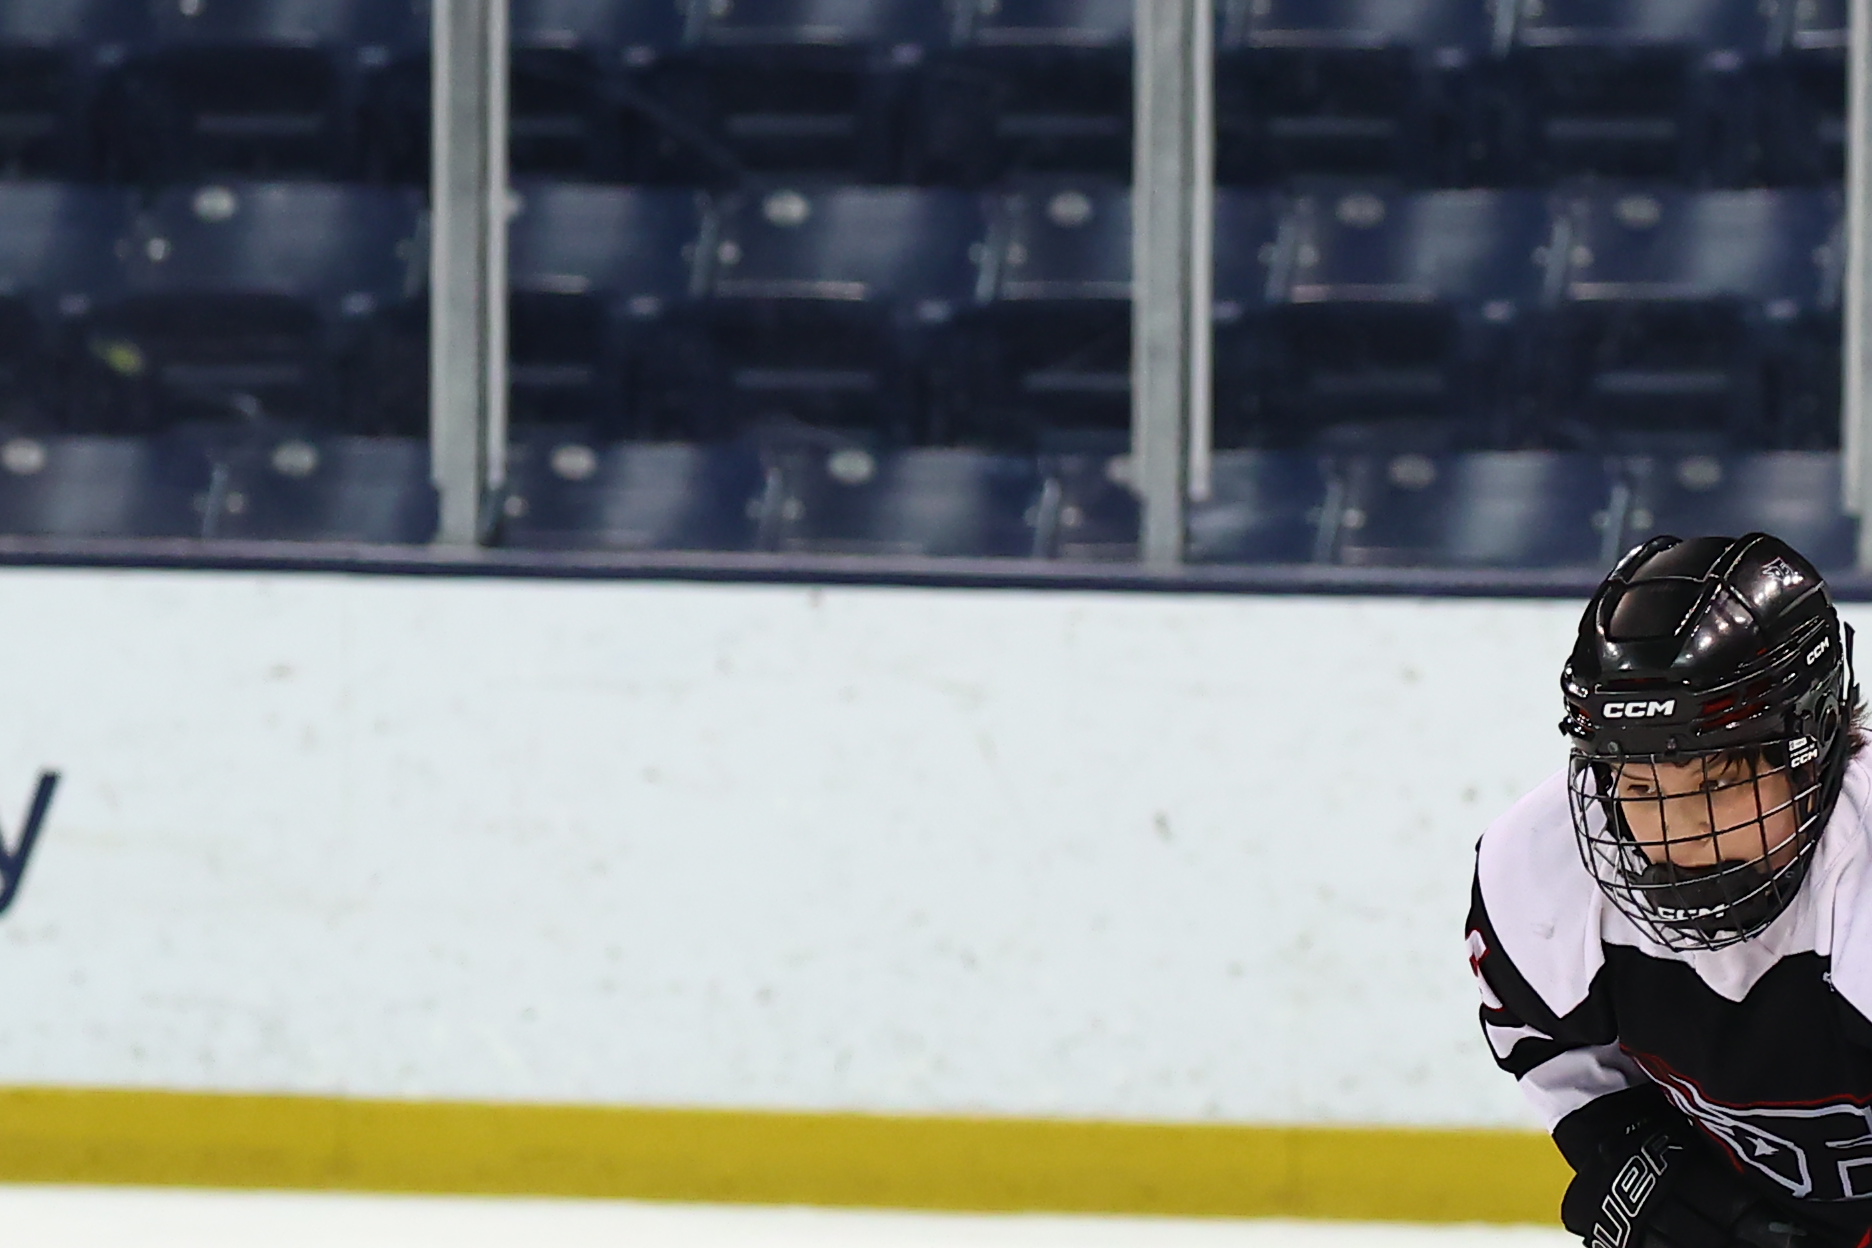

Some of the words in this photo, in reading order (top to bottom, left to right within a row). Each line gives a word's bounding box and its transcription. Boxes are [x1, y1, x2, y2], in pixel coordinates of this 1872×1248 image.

[1806, 636, 1830, 666] CCM
[1603, 699, 1676, 718] CCM
[1790, 748, 1819, 768] CCM
